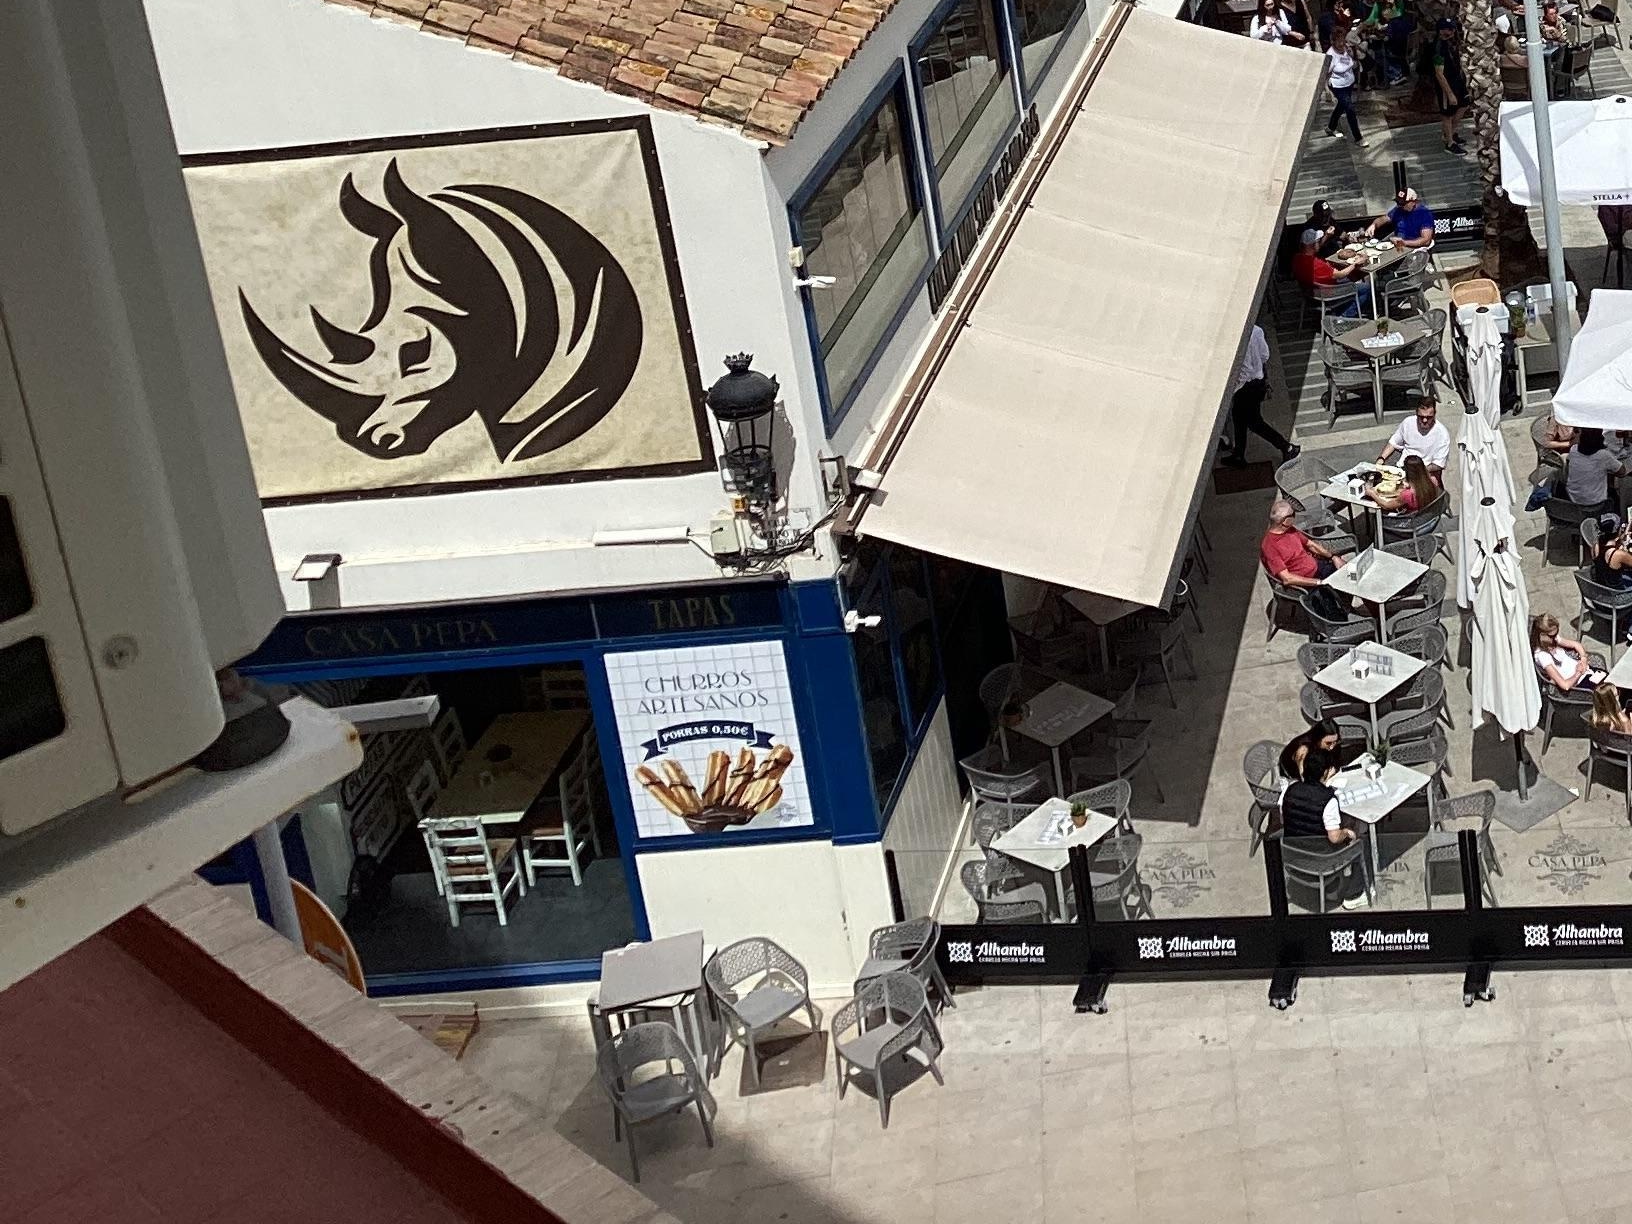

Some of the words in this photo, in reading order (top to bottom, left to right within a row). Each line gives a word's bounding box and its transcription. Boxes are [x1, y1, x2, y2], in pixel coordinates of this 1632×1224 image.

[1592, 193, 1623, 201] STELLA
[648, 594, 737, 630] TAPAS
[644, 669, 752, 694] CHURROS
[637, 689, 769, 715] ARTESANOS
[661, 725, 709, 743] PORRAS
[1527, 856, 1567, 868] CASA
[1572, 856, 1607, 867] PEPA
[1359, 929, 1429, 946] Alhambra
[1552, 923, 1623, 940] Alhambra
[975, 941, 1044, 957] Alhambra
[1166, 935, 1236, 952] Alhambra
